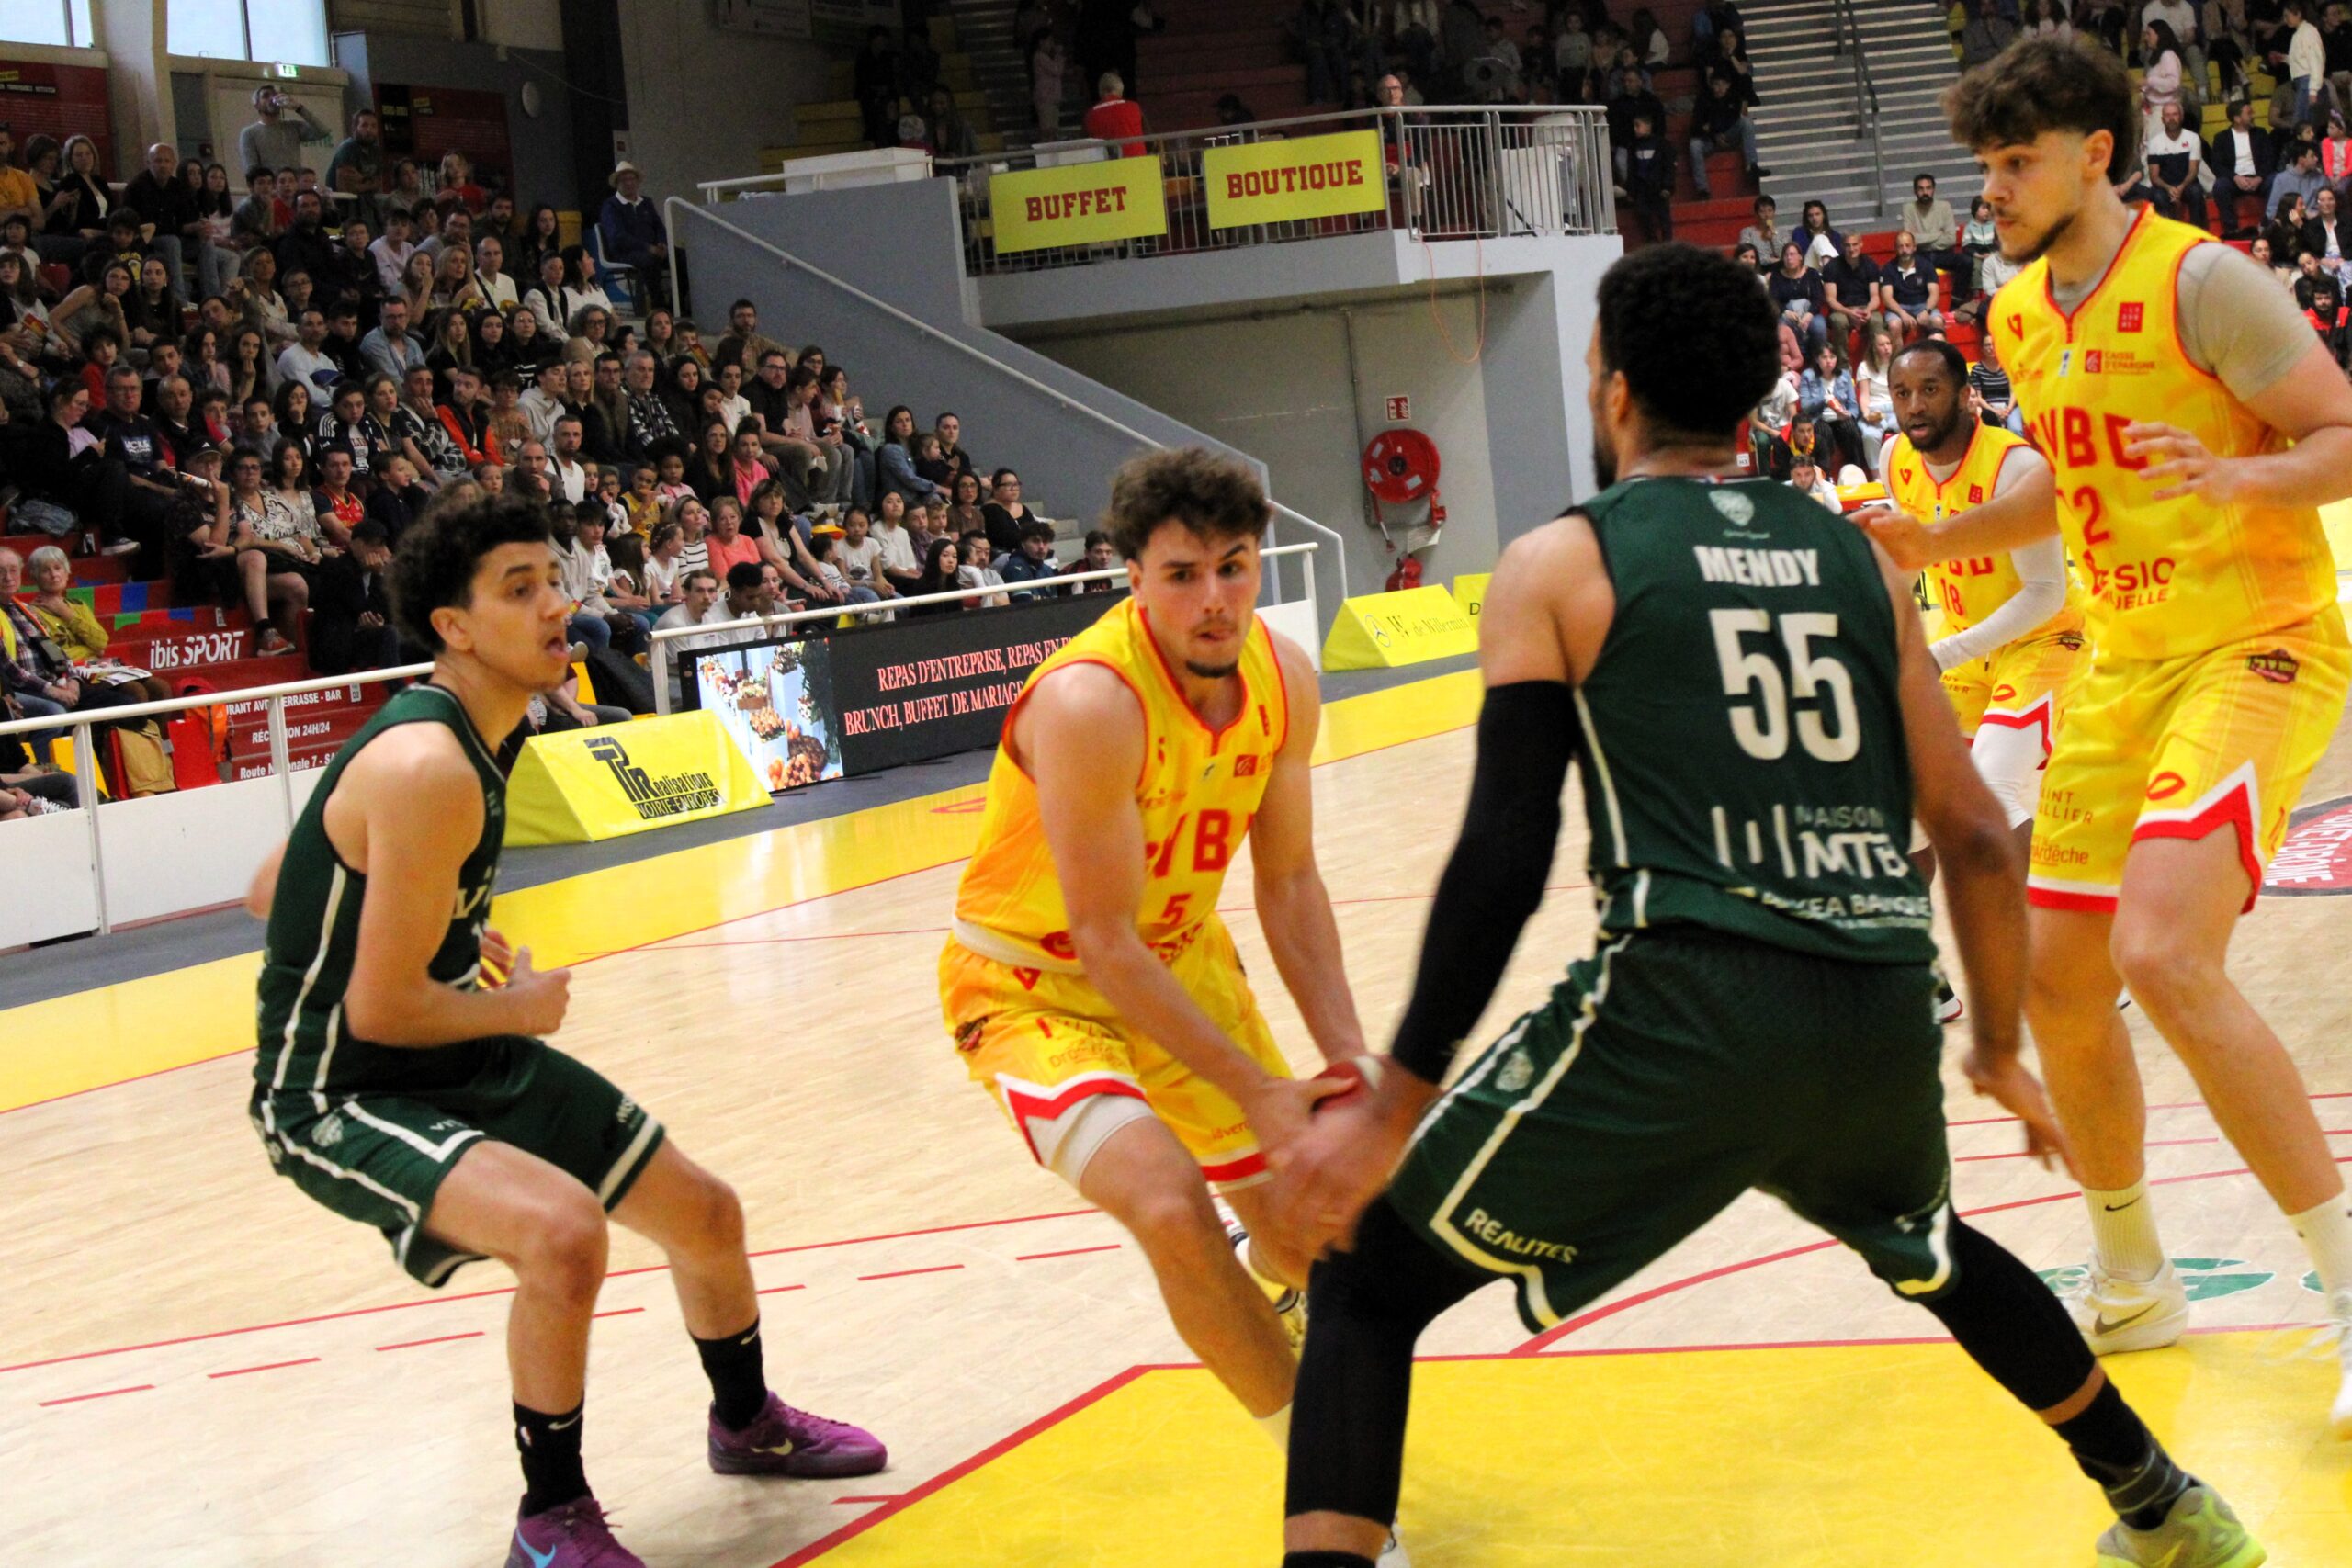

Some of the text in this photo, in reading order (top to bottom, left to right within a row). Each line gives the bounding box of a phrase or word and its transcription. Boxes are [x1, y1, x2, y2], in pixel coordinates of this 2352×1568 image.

[1226, 159, 1364, 199] BOUTIQUE
[1025, 186, 1127, 222] BUFFET
[1693, 545, 1820, 588] MENDY
[1940, 578, 1963, 616] 18
[150, 631, 245, 669] ibis SPORT
[877, 662, 917, 691] REPAS
[917, 648, 1007, 684] D'ENTREPRISE,
[1007, 642, 1043, 669] REPAS
[282, 692, 320, 708] ERRASSE
[325, 689, 342, 702] BAR
[1707, 608, 1860, 763] 55
[302, 721, 331, 737] 24H/24
[844, 703, 904, 736] BRUNCH,
[903, 694, 949, 725] BUFFET
[952, 690, 970, 716] DE
[240, 766, 266, 780] Route
[311, 755, 318, 767] 7
[1160, 893, 1193, 927] 5
